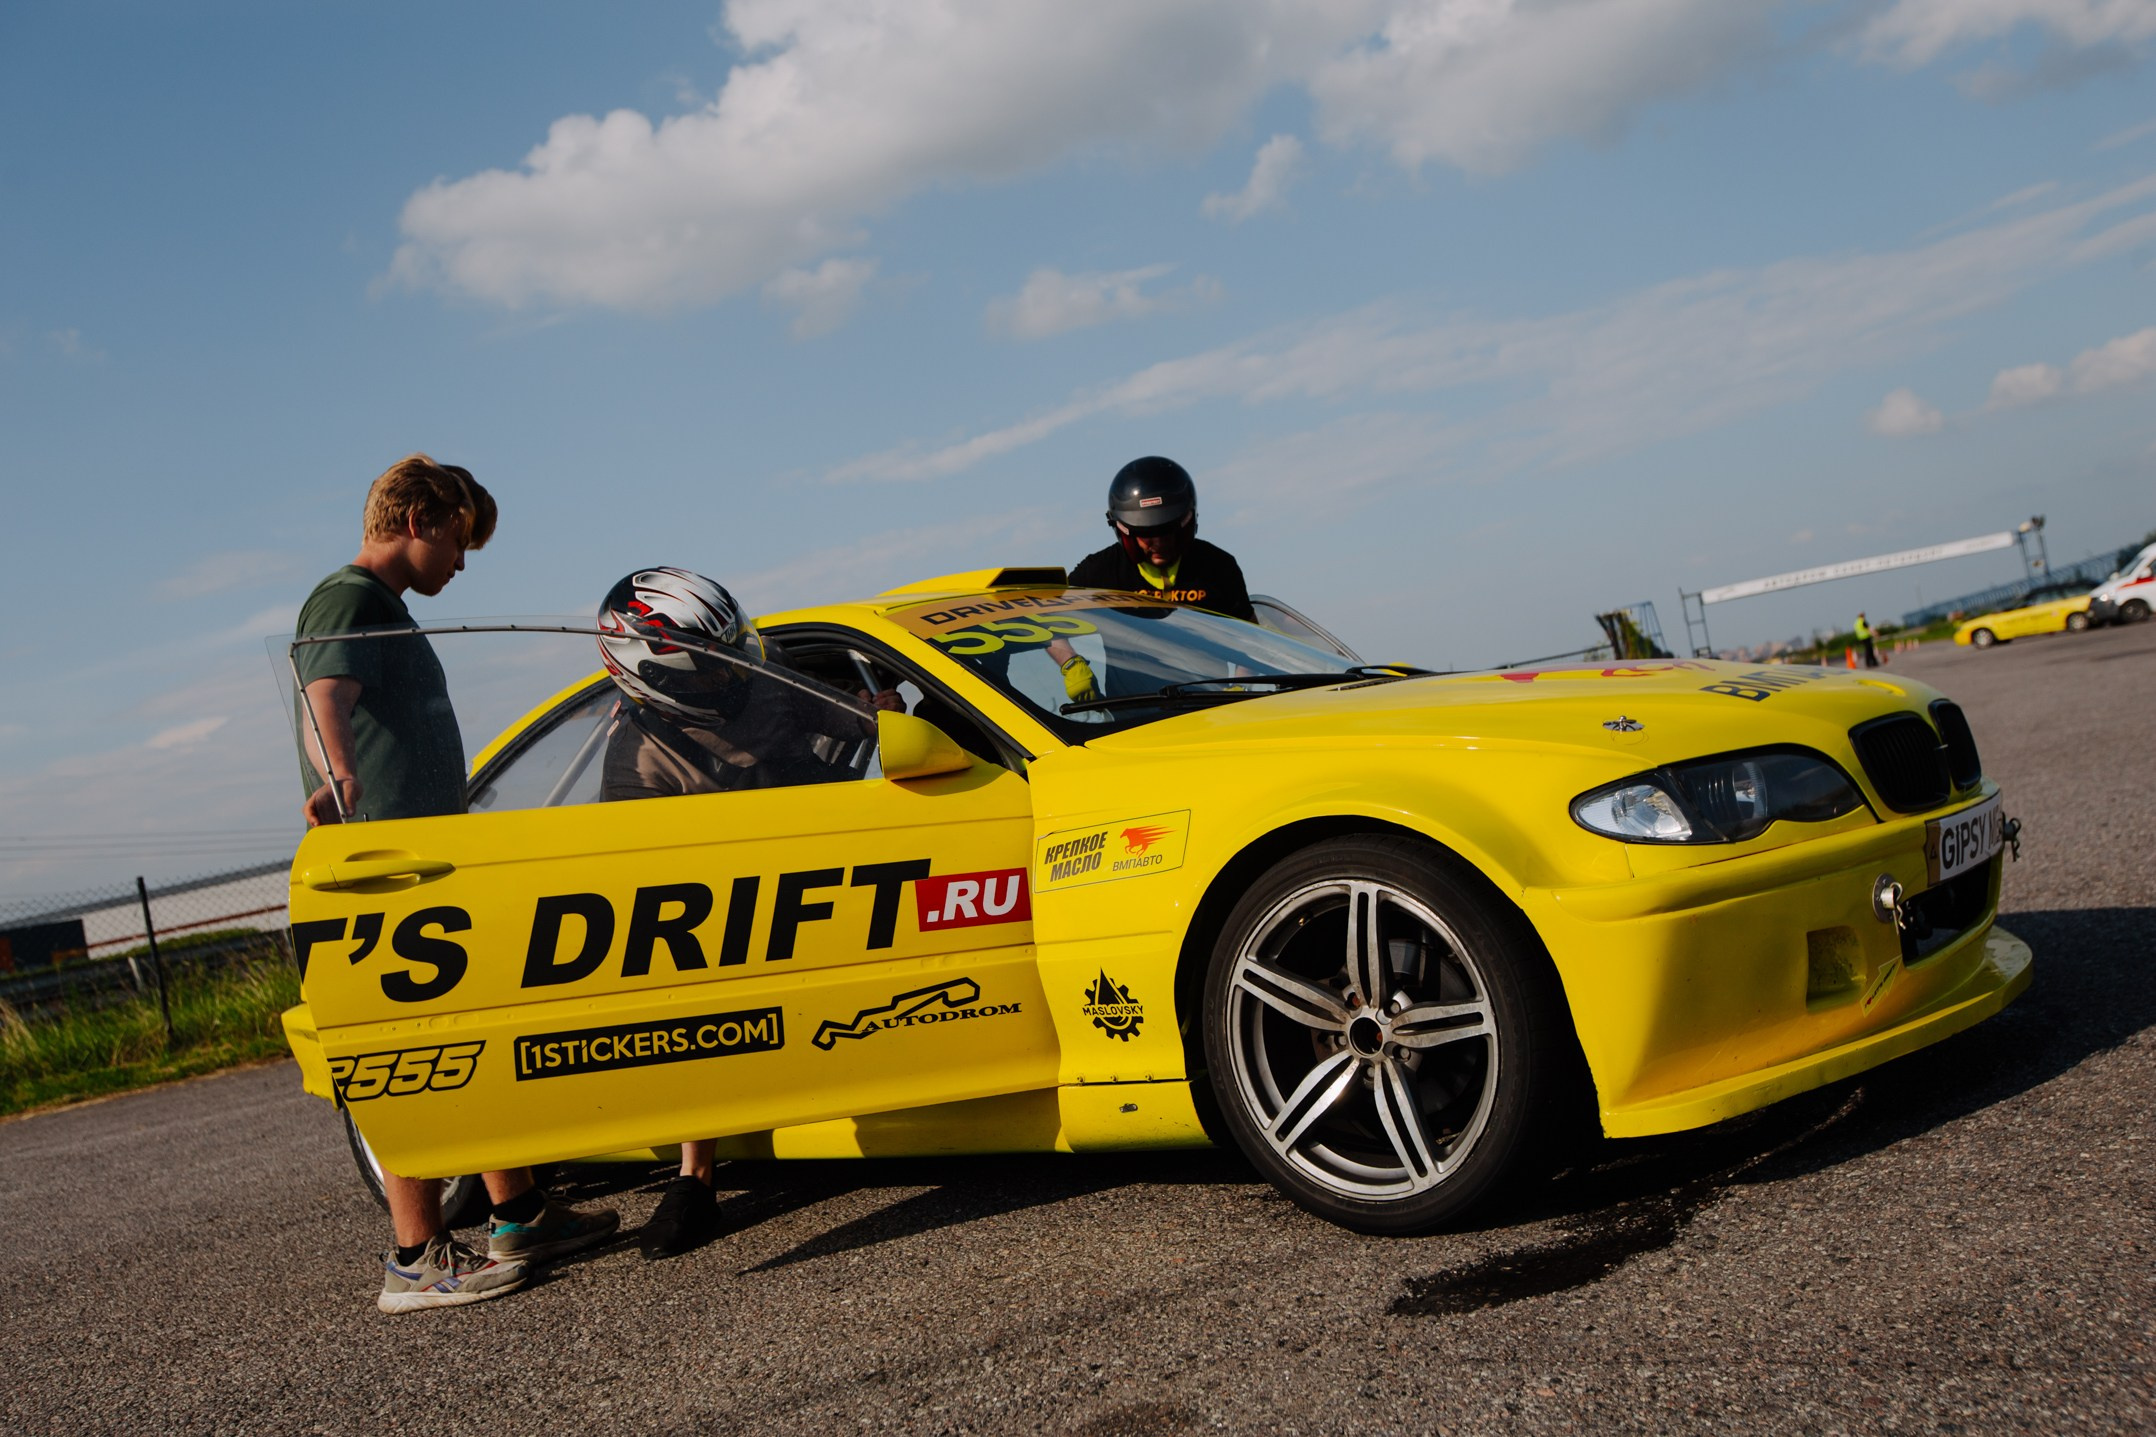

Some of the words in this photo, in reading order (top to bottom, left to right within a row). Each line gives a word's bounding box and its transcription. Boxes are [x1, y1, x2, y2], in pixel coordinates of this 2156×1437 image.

[936, 613, 1097, 655] 555
[1044, 831, 1108, 864] КРЕПКОЕ
[1941, 813, 1987, 870] GIPSY
[1050, 852, 1102, 882] МАСЛО
[1112, 854, 1163, 872] ВМПАВТО
[520, 858, 931, 989] DRIFT
[861, 1003, 1022, 1033] AUTODROM
[1082, 1004, 1144, 1016] MASLOVSKY
